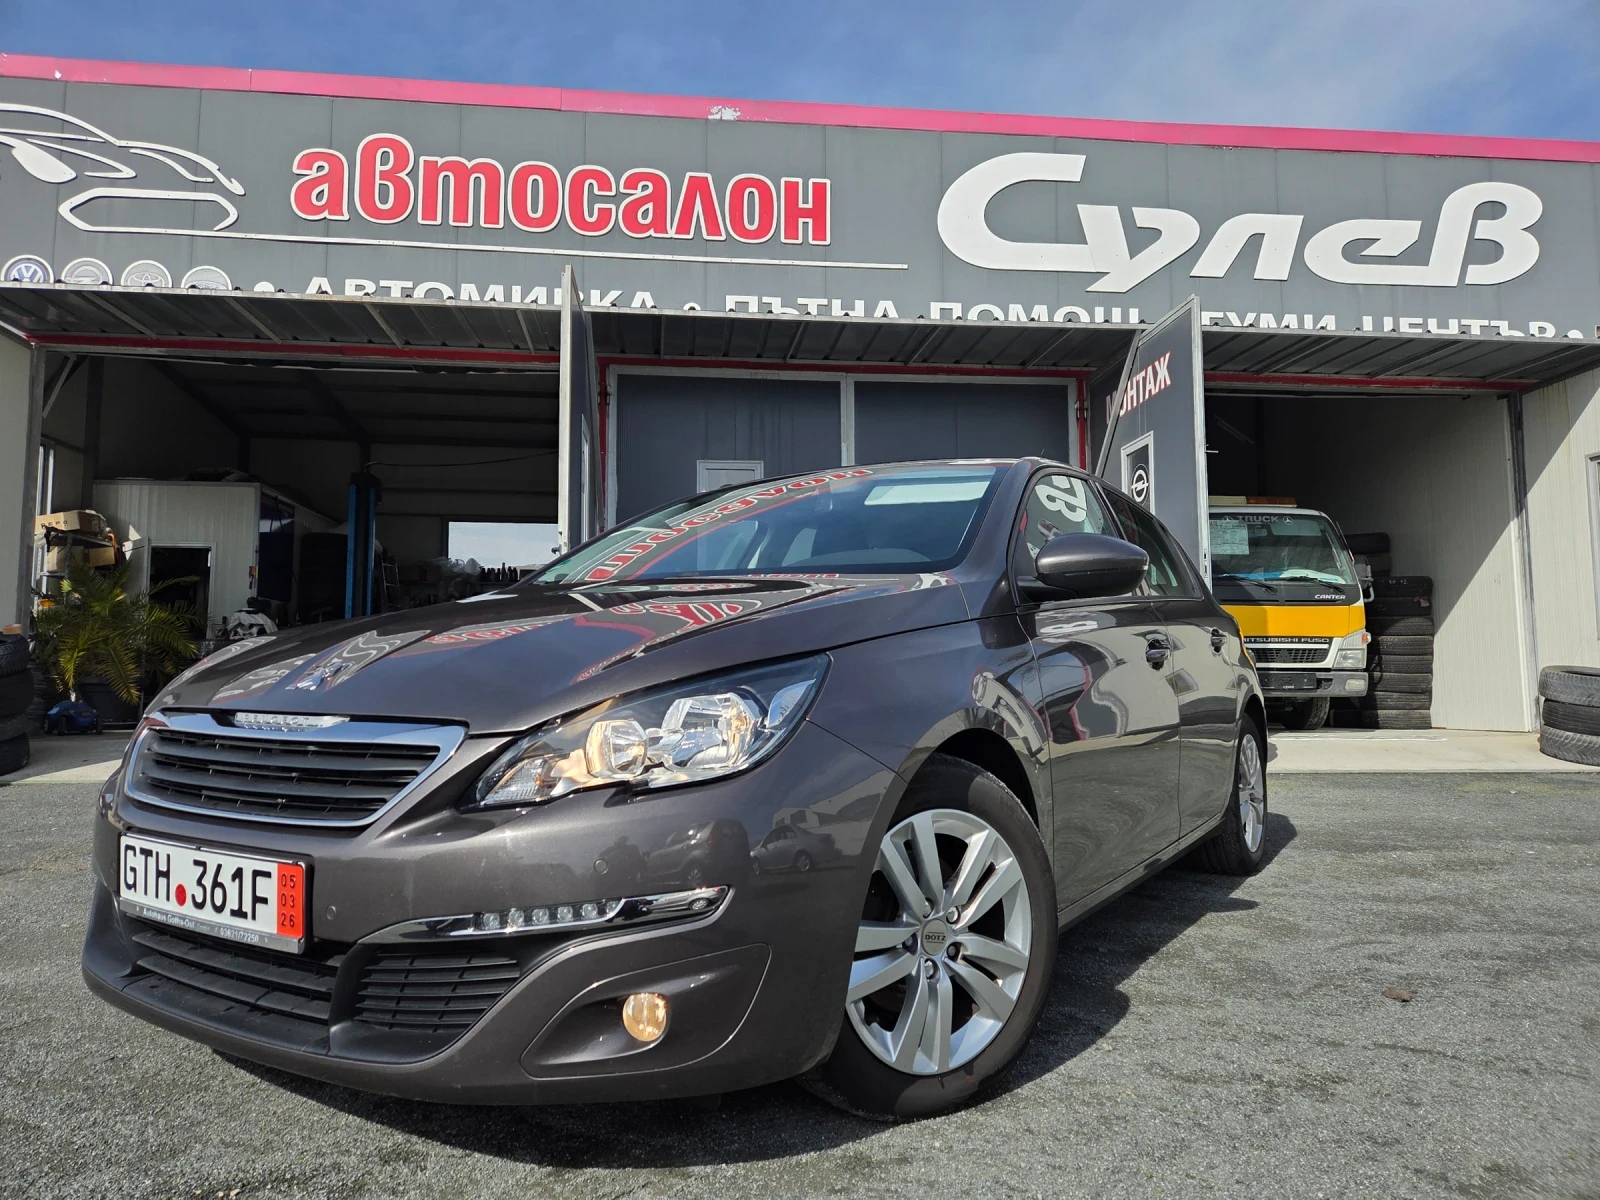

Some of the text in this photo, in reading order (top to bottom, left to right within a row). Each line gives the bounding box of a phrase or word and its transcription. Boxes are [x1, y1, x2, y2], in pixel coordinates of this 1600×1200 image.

[290, 133, 831, 246] автосалон
[937, 152, 1543, 293] Сулев
[1235, 515, 1280, 523] TRUCK
[243, 713, 310, 725] PEUGEOT
[123, 844, 272, 921] GTH 361F
[281, 873, 296, 889] 05
[281, 892, 296, 908] 03
[143, 908, 167, 922] Autohaus
[280, 912, 296, 928] 26
[924, 934, 947, 942] DOTZ
